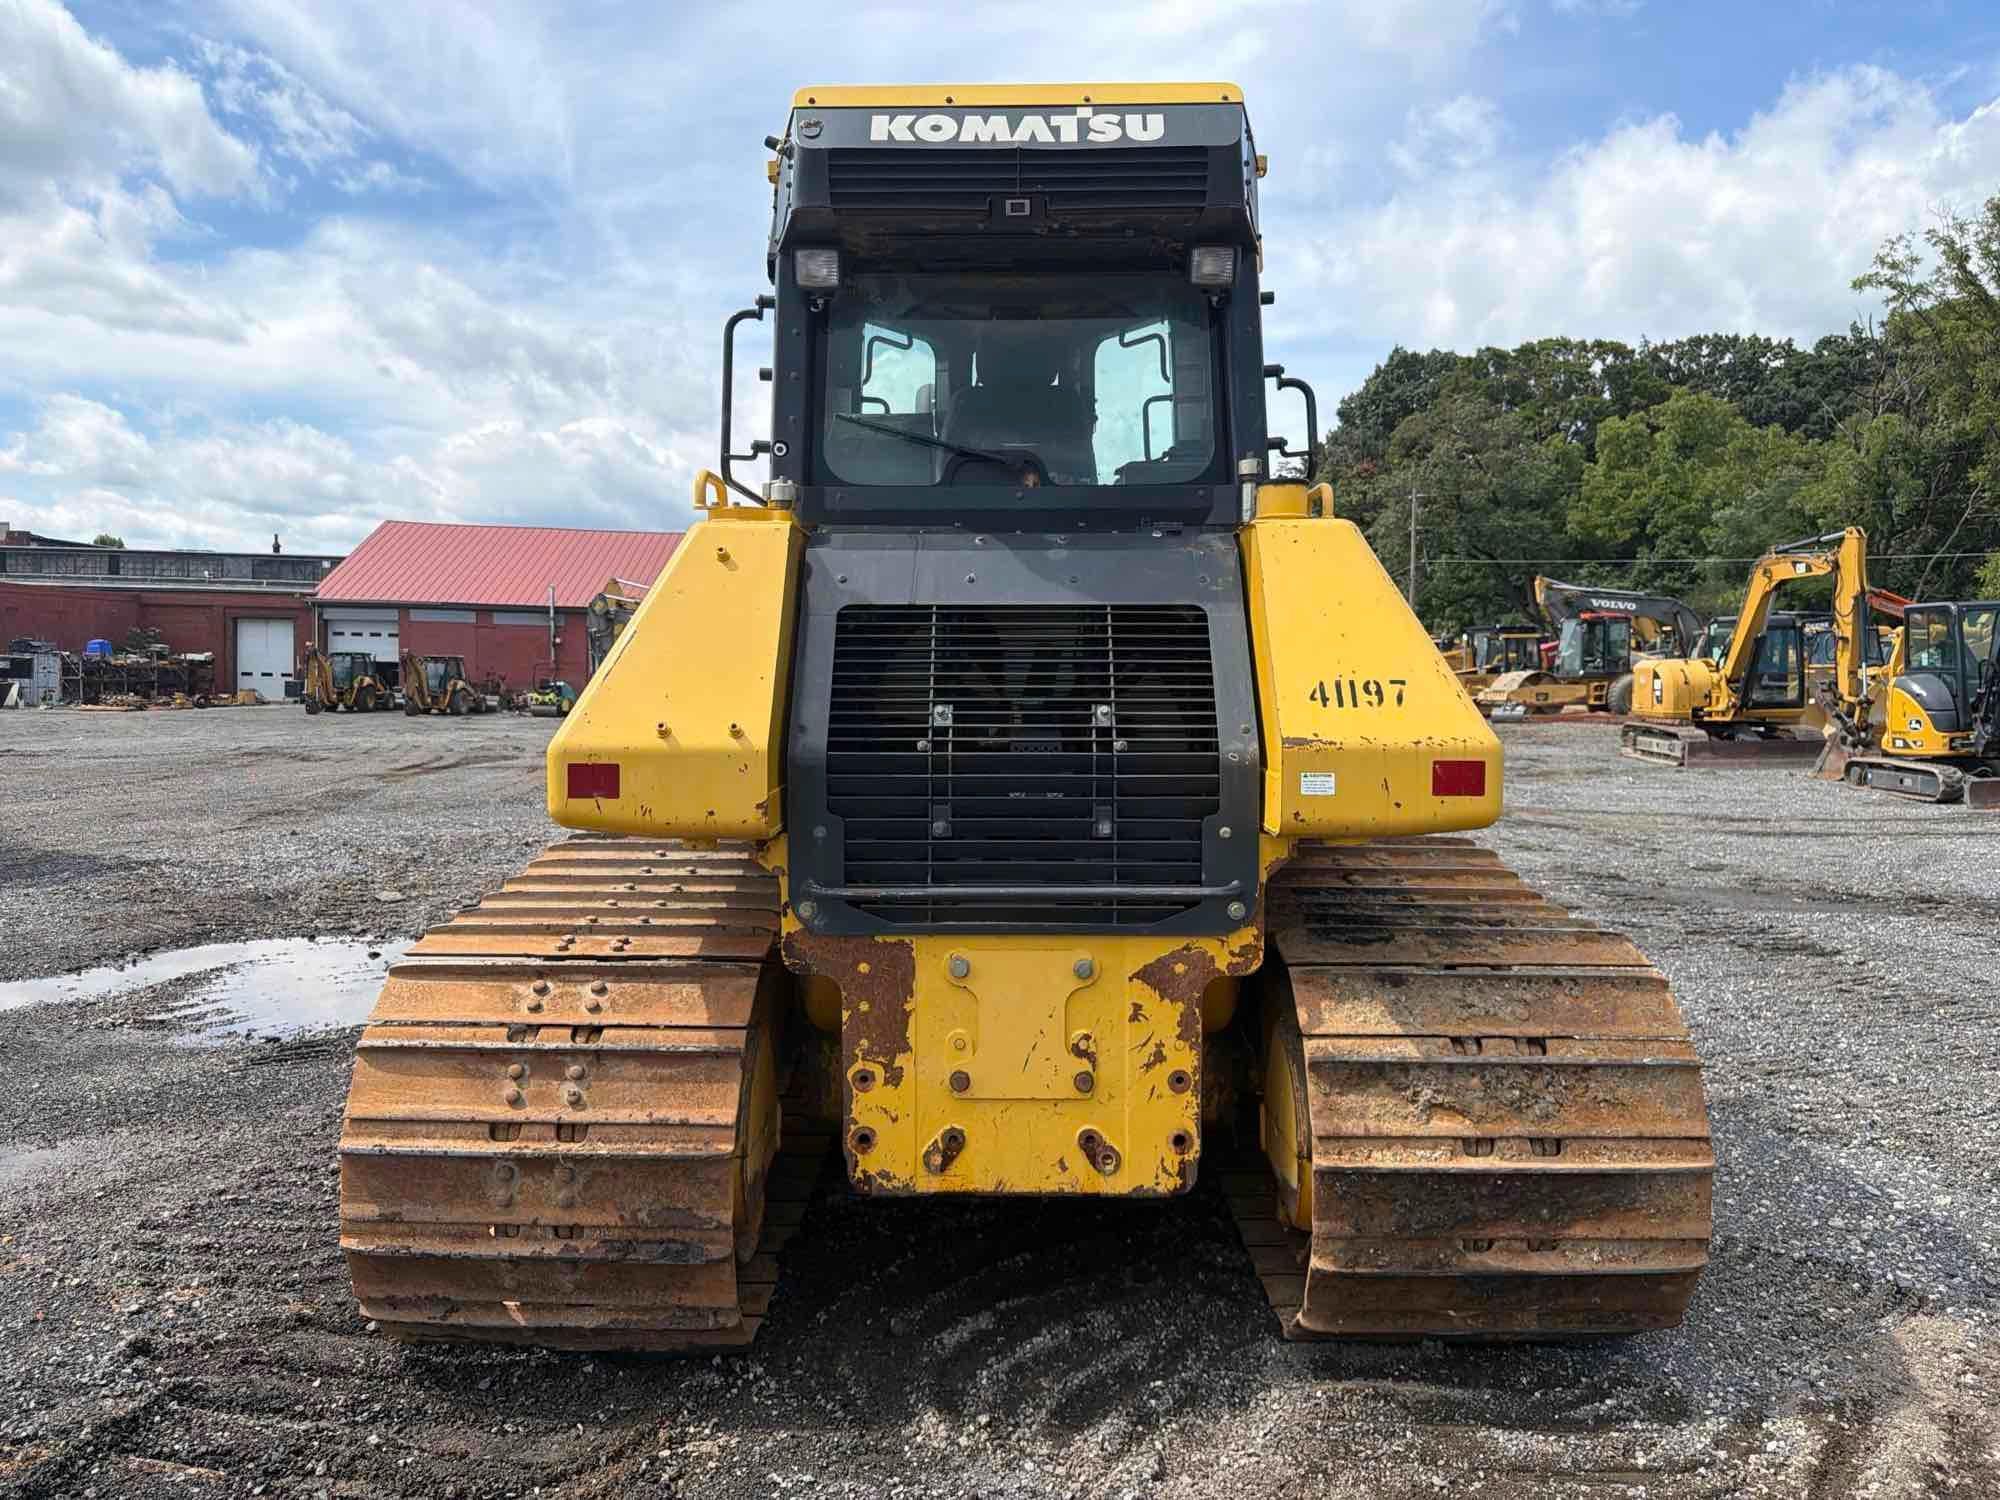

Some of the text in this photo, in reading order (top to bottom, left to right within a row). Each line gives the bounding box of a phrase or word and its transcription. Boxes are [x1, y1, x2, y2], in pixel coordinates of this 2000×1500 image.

[869, 107, 1165, 142] KOMATSU
[1591, 599, 1636, 610] VOLVO
[1309, 679, 1406, 708] 41197
